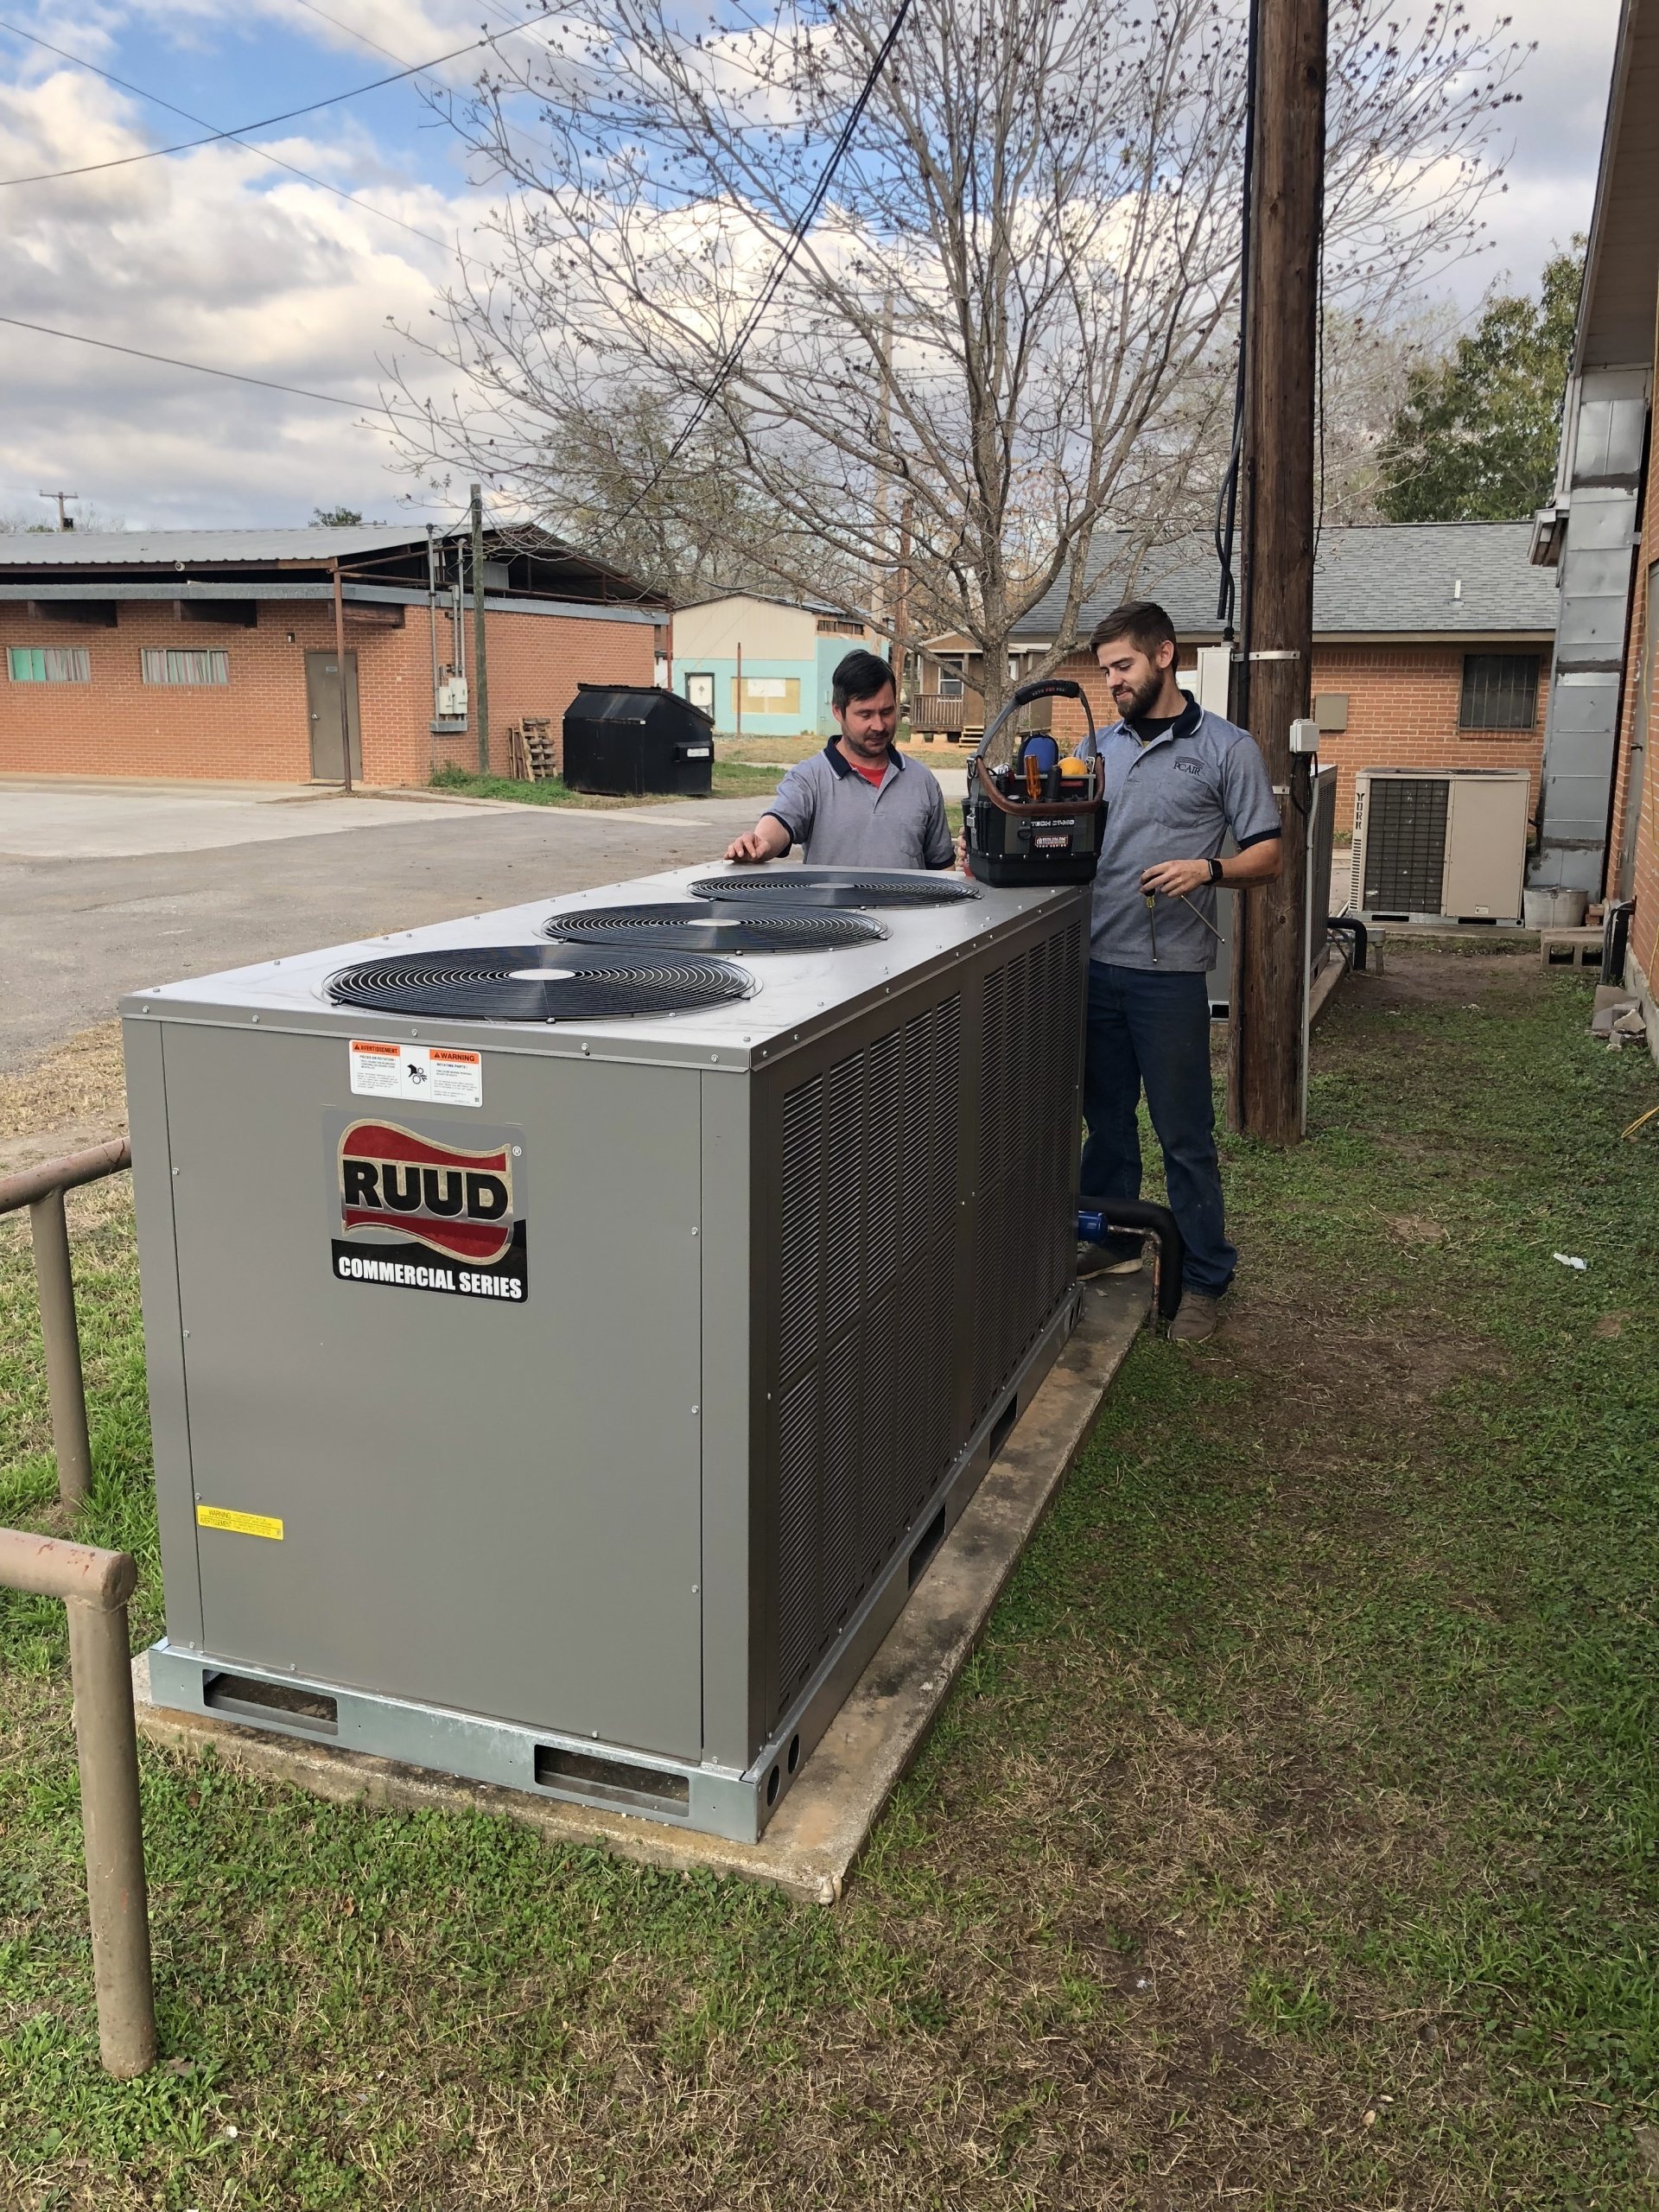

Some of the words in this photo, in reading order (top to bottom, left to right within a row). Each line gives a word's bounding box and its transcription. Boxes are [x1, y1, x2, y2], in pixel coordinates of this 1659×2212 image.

[1355, 792, 1365, 830] YORK
[360, 1045, 397, 1054] AVERTISSEMENT
[441, 1052, 475, 1062] WARNING
[342, 1160, 509, 1221] RUUD
[338, 1256, 456, 1291] COMMERCIAL
[459, 1272, 522, 1299] SERIES
[208, 1509, 232, 1519] WARNING
